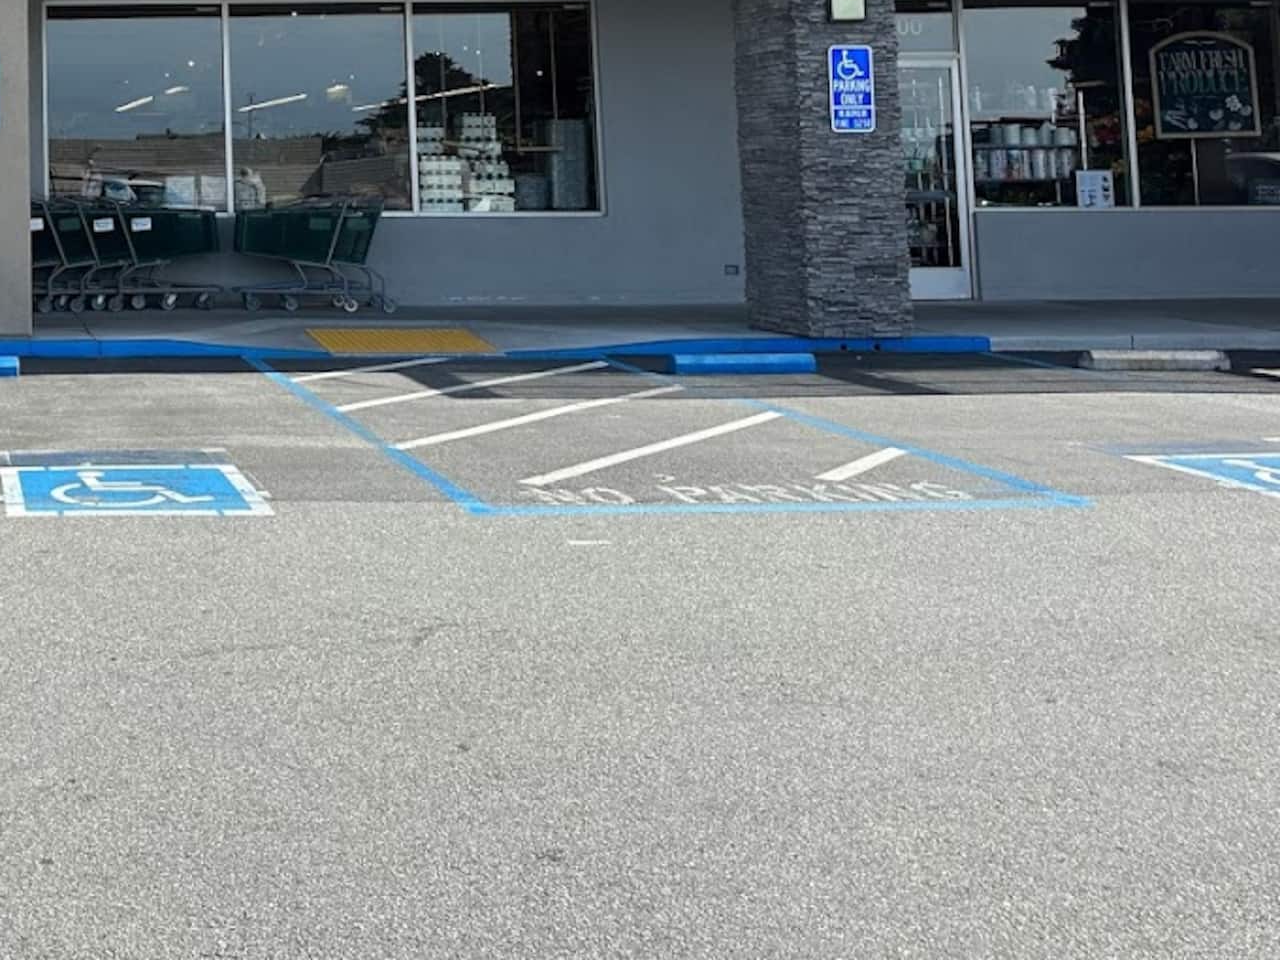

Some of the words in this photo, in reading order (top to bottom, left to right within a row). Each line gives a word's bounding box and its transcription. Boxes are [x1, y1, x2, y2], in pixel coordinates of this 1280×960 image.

[833, 79, 871, 93] PARKING
[841, 93, 863, 105] ONLY
[521, 486, 634, 504] NO
[657, 481, 971, 504] PARKING
